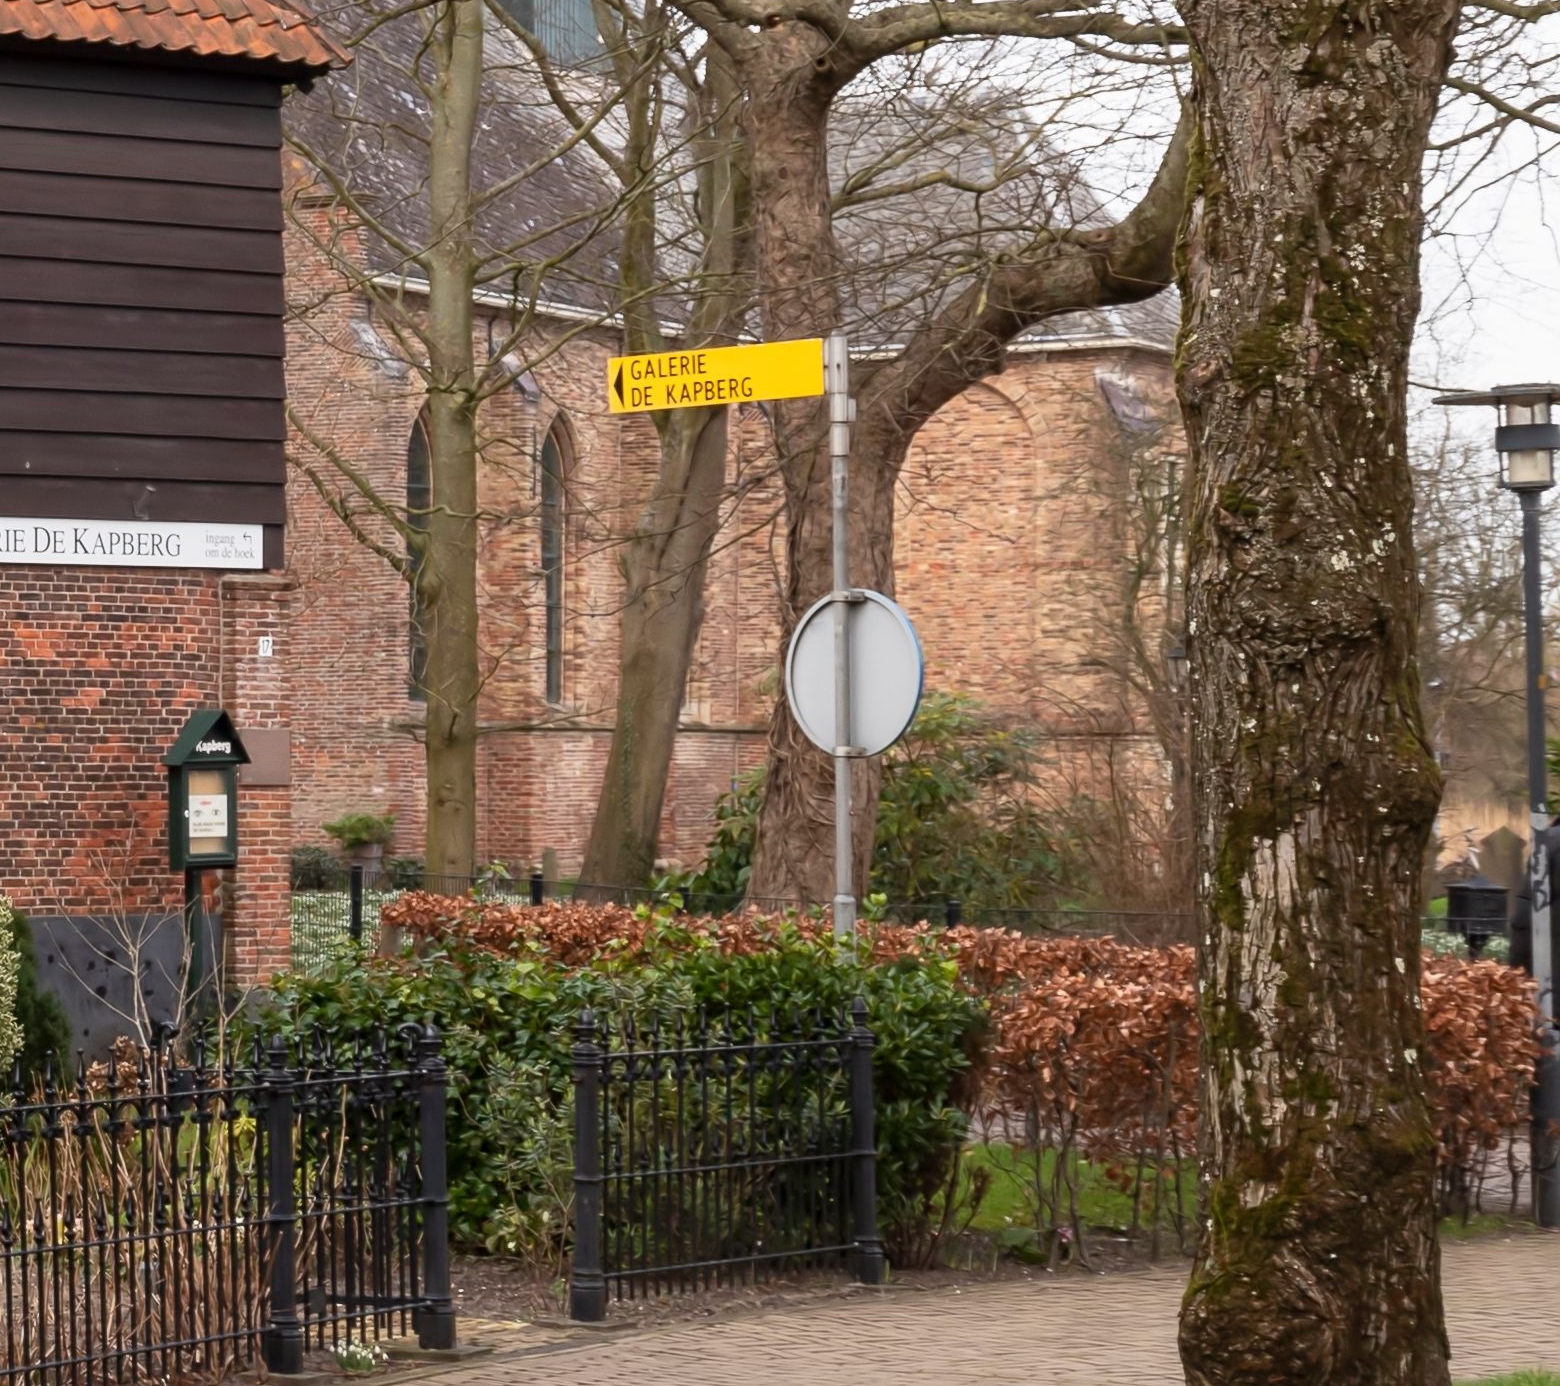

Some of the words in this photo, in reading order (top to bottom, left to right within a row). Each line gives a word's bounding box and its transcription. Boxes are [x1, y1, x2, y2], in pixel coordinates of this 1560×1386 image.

[631, 353, 707, 381] GALERIE
[631, 386, 653, 407] DE
[666, 377, 753, 404] KAPBERG
[73, 527, 181, 557] KAPBERG
[205, 530, 235, 547] ingang
[205, 549, 220, 558] om
[221, 547, 232, 559] de
[234, 548, 255, 559] hoek
[262, 639, 270, 654] 17
